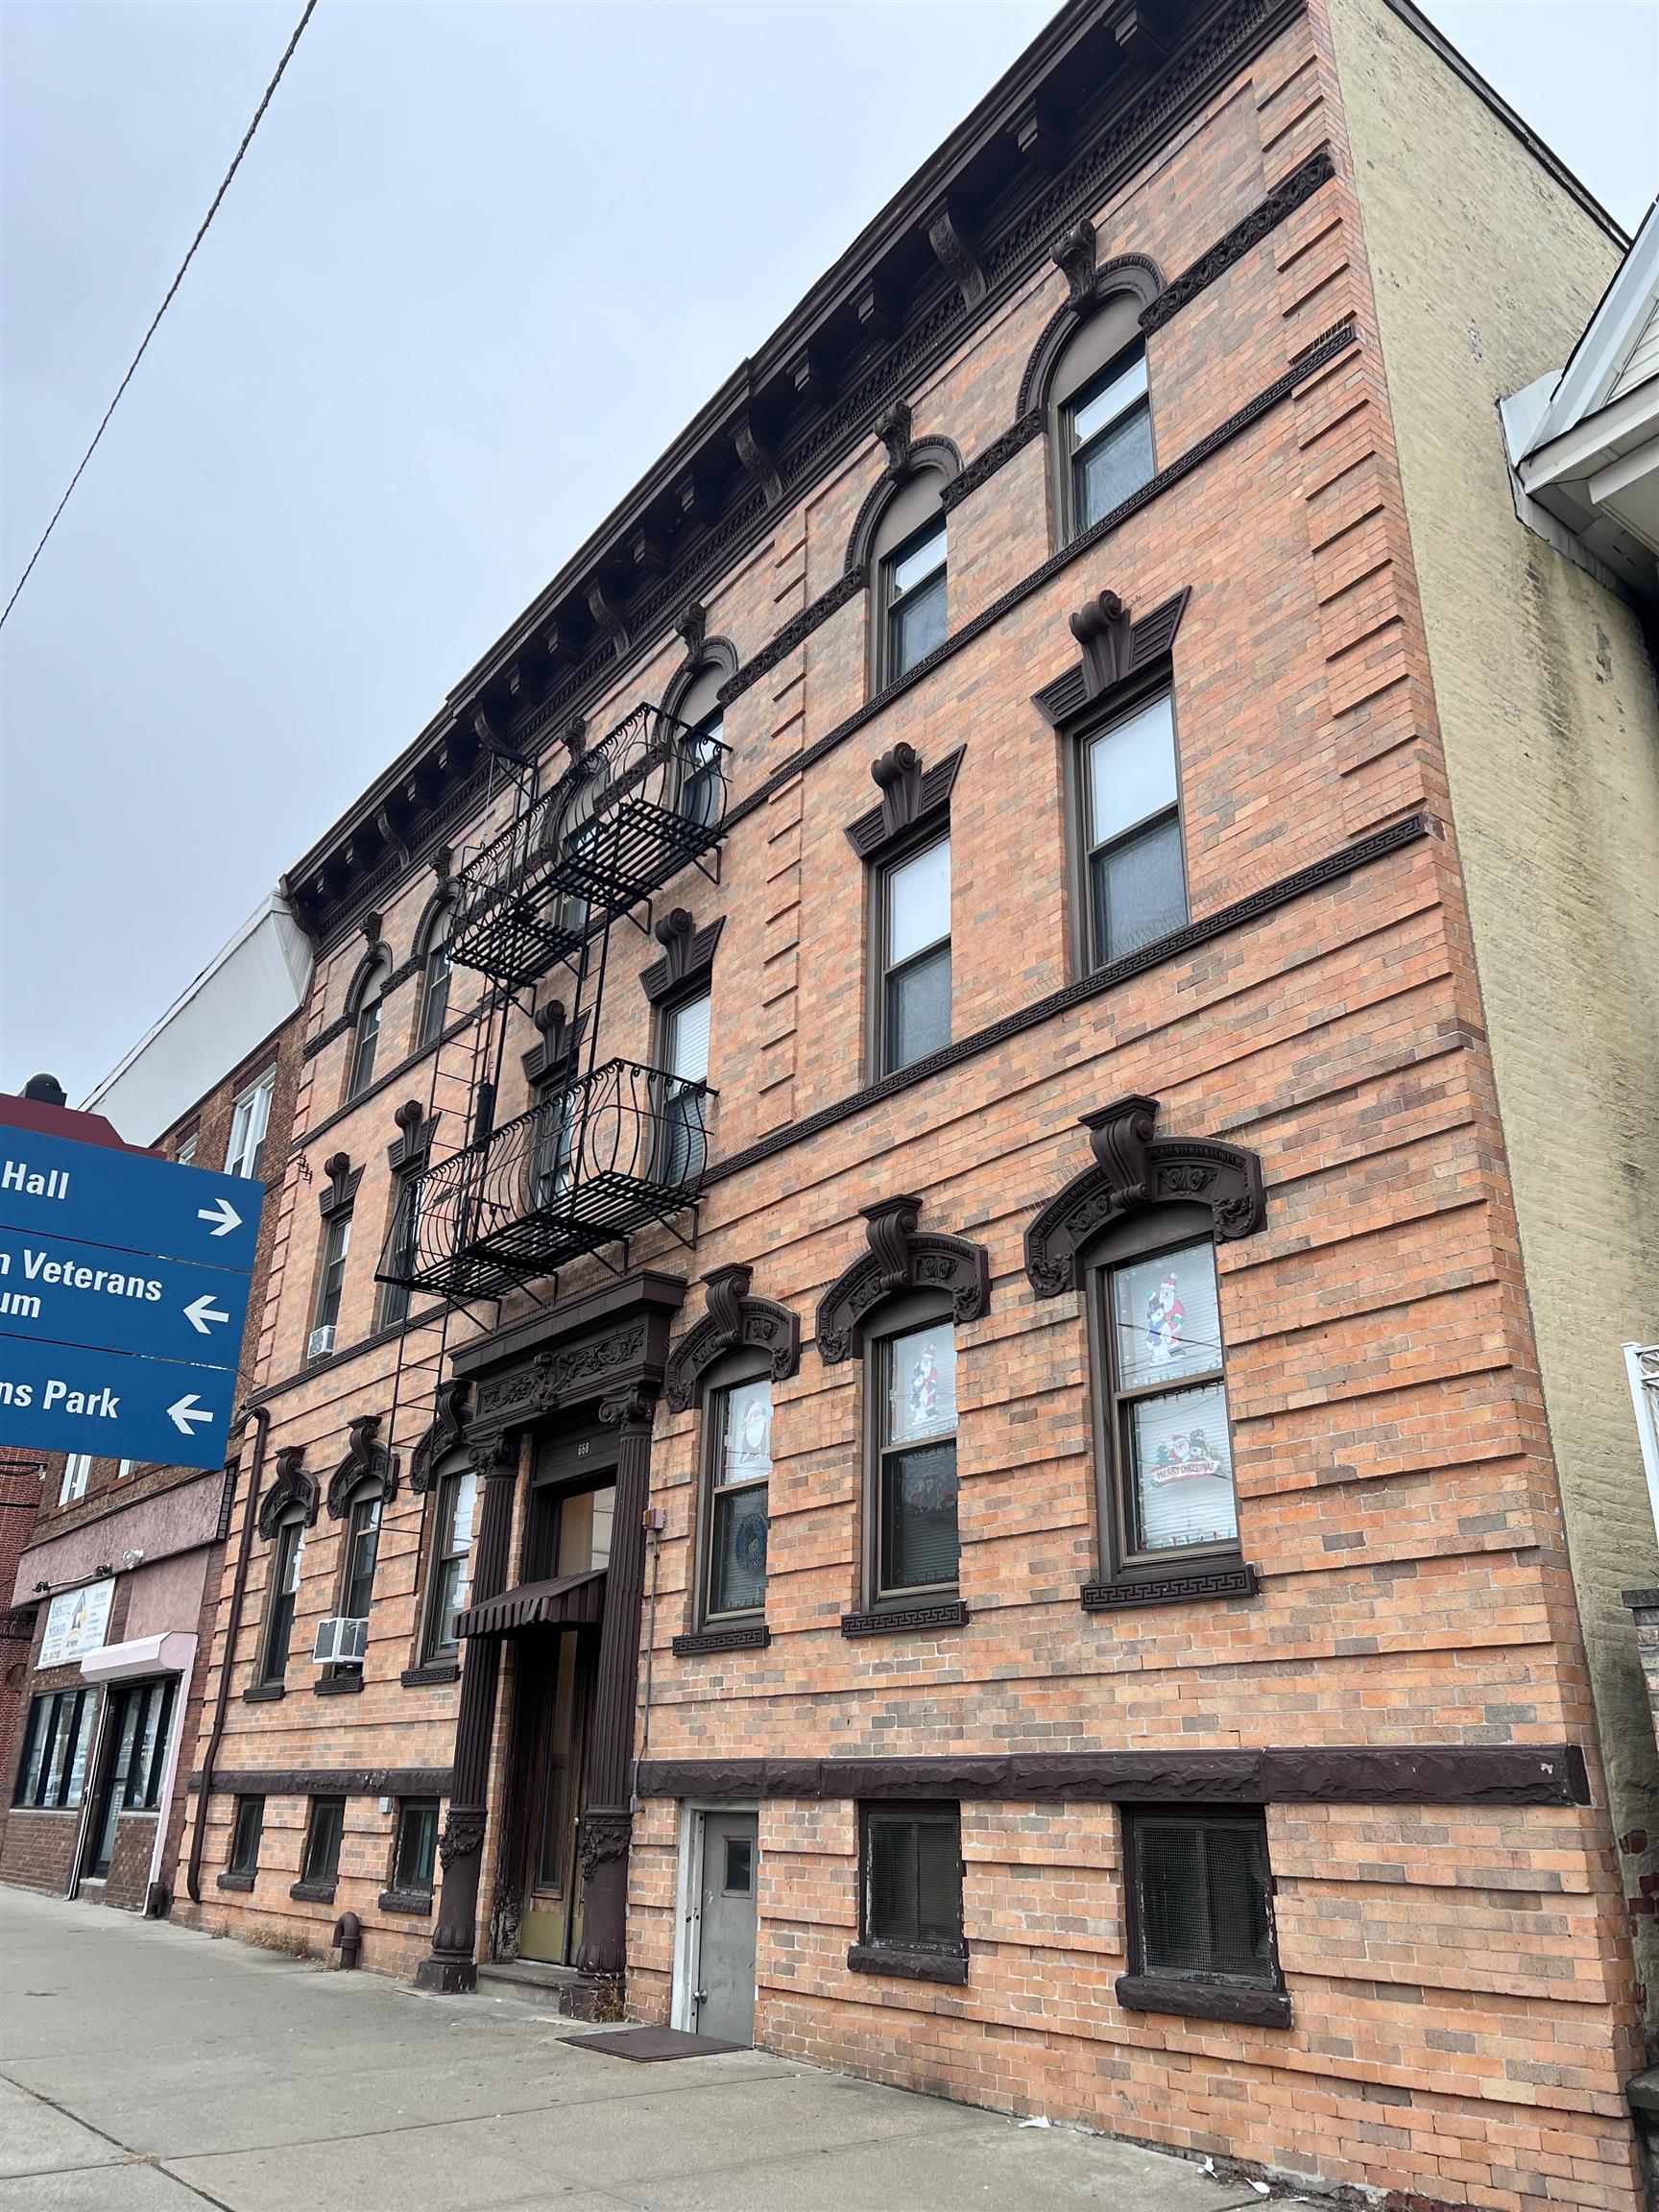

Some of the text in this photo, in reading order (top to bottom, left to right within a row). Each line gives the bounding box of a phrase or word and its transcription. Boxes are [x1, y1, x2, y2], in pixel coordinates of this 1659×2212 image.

[1, 1160, 70, 1200] Hall
[23, 1249, 163, 1302] Veterans
[42, 1380, 121, 1419] Park
